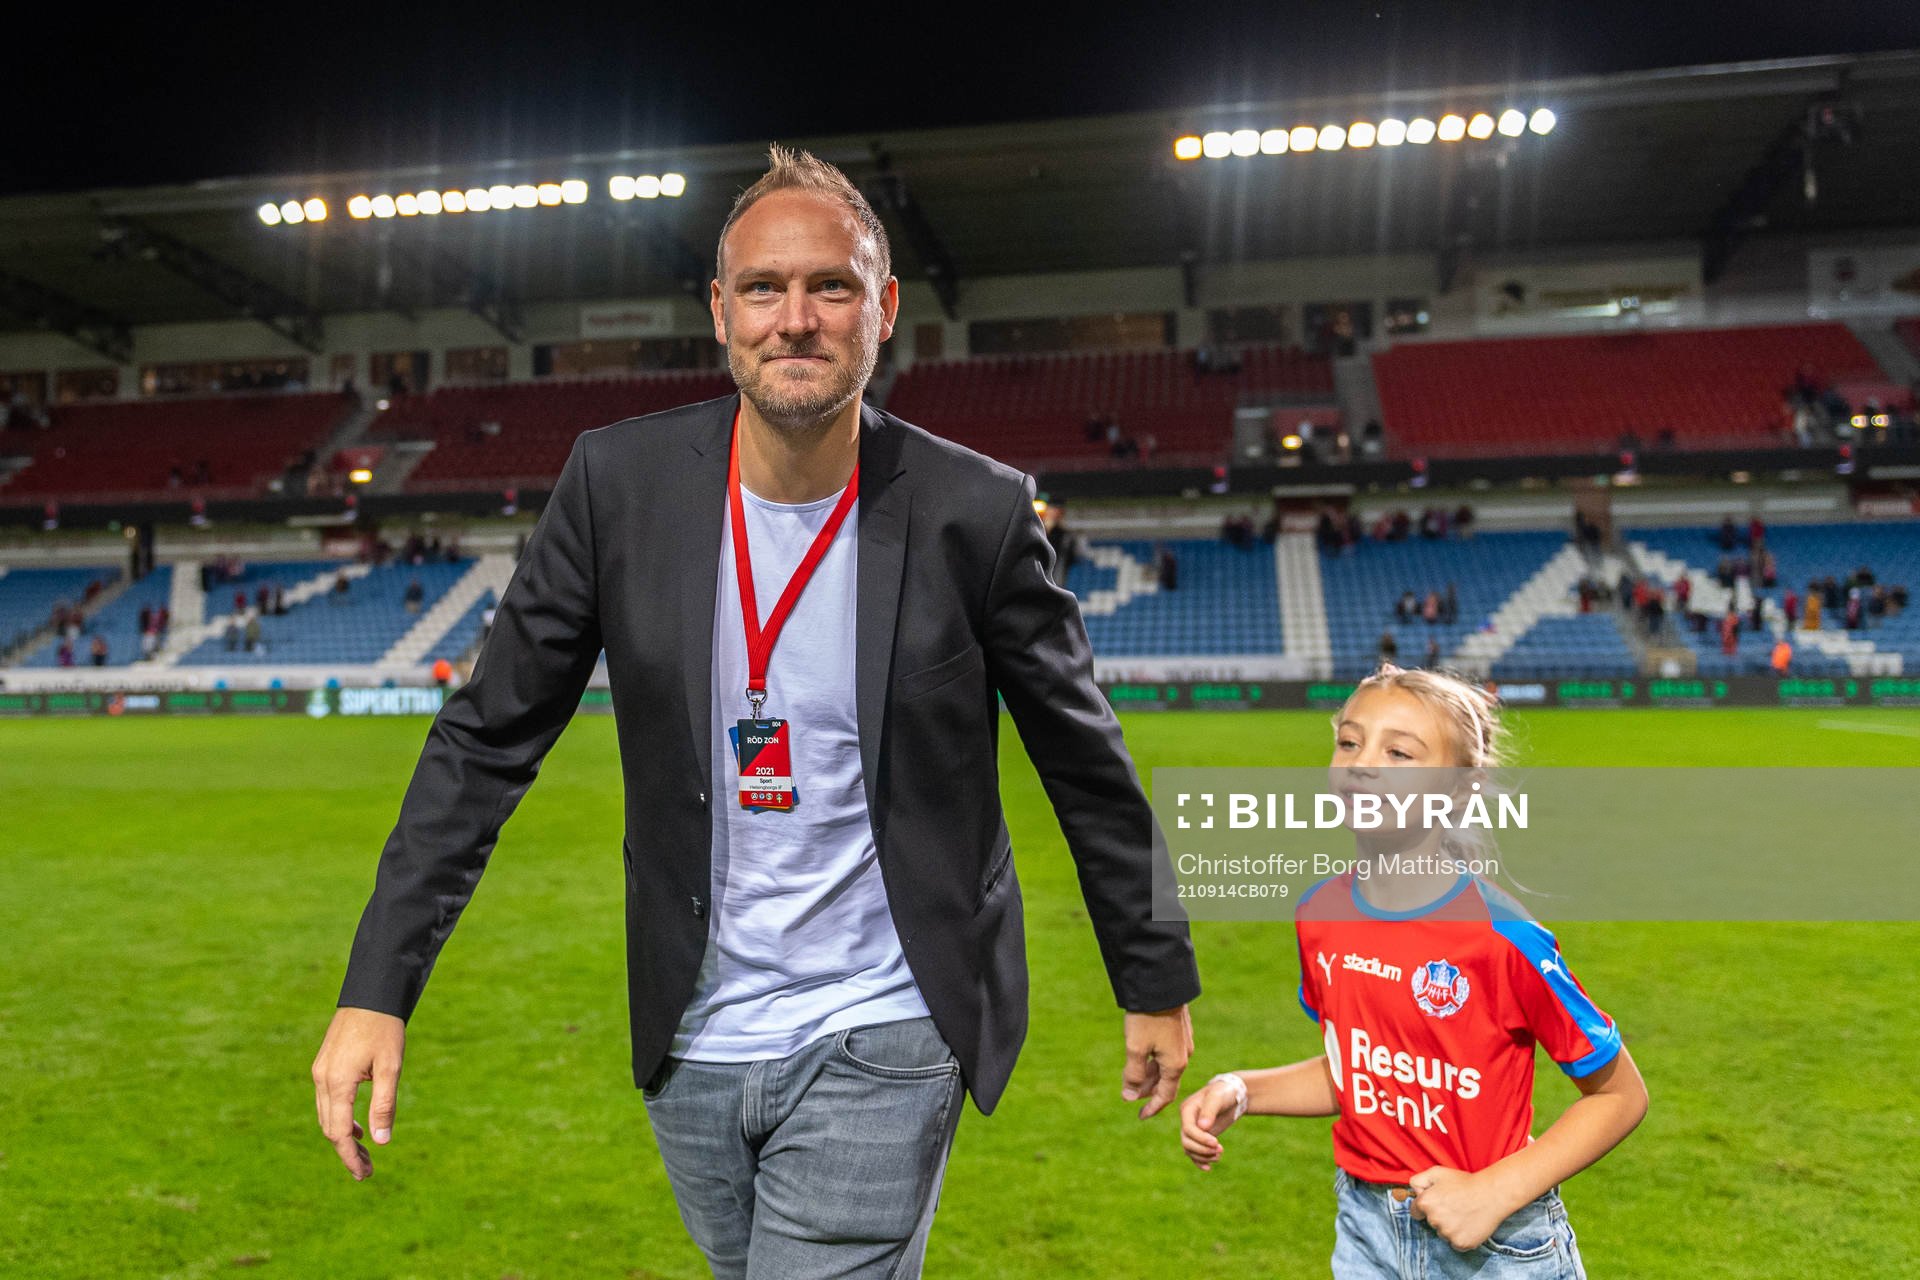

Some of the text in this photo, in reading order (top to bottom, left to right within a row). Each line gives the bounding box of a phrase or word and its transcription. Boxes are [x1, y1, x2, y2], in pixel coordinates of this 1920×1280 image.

[747, 736, 762, 744] RÖD
[756, 767, 774, 776] 2021
[1342, 953, 1402, 982] stadium
[1350, 1027, 1482, 1100] Resurs
[1352, 1072, 1448, 1134] Bank
